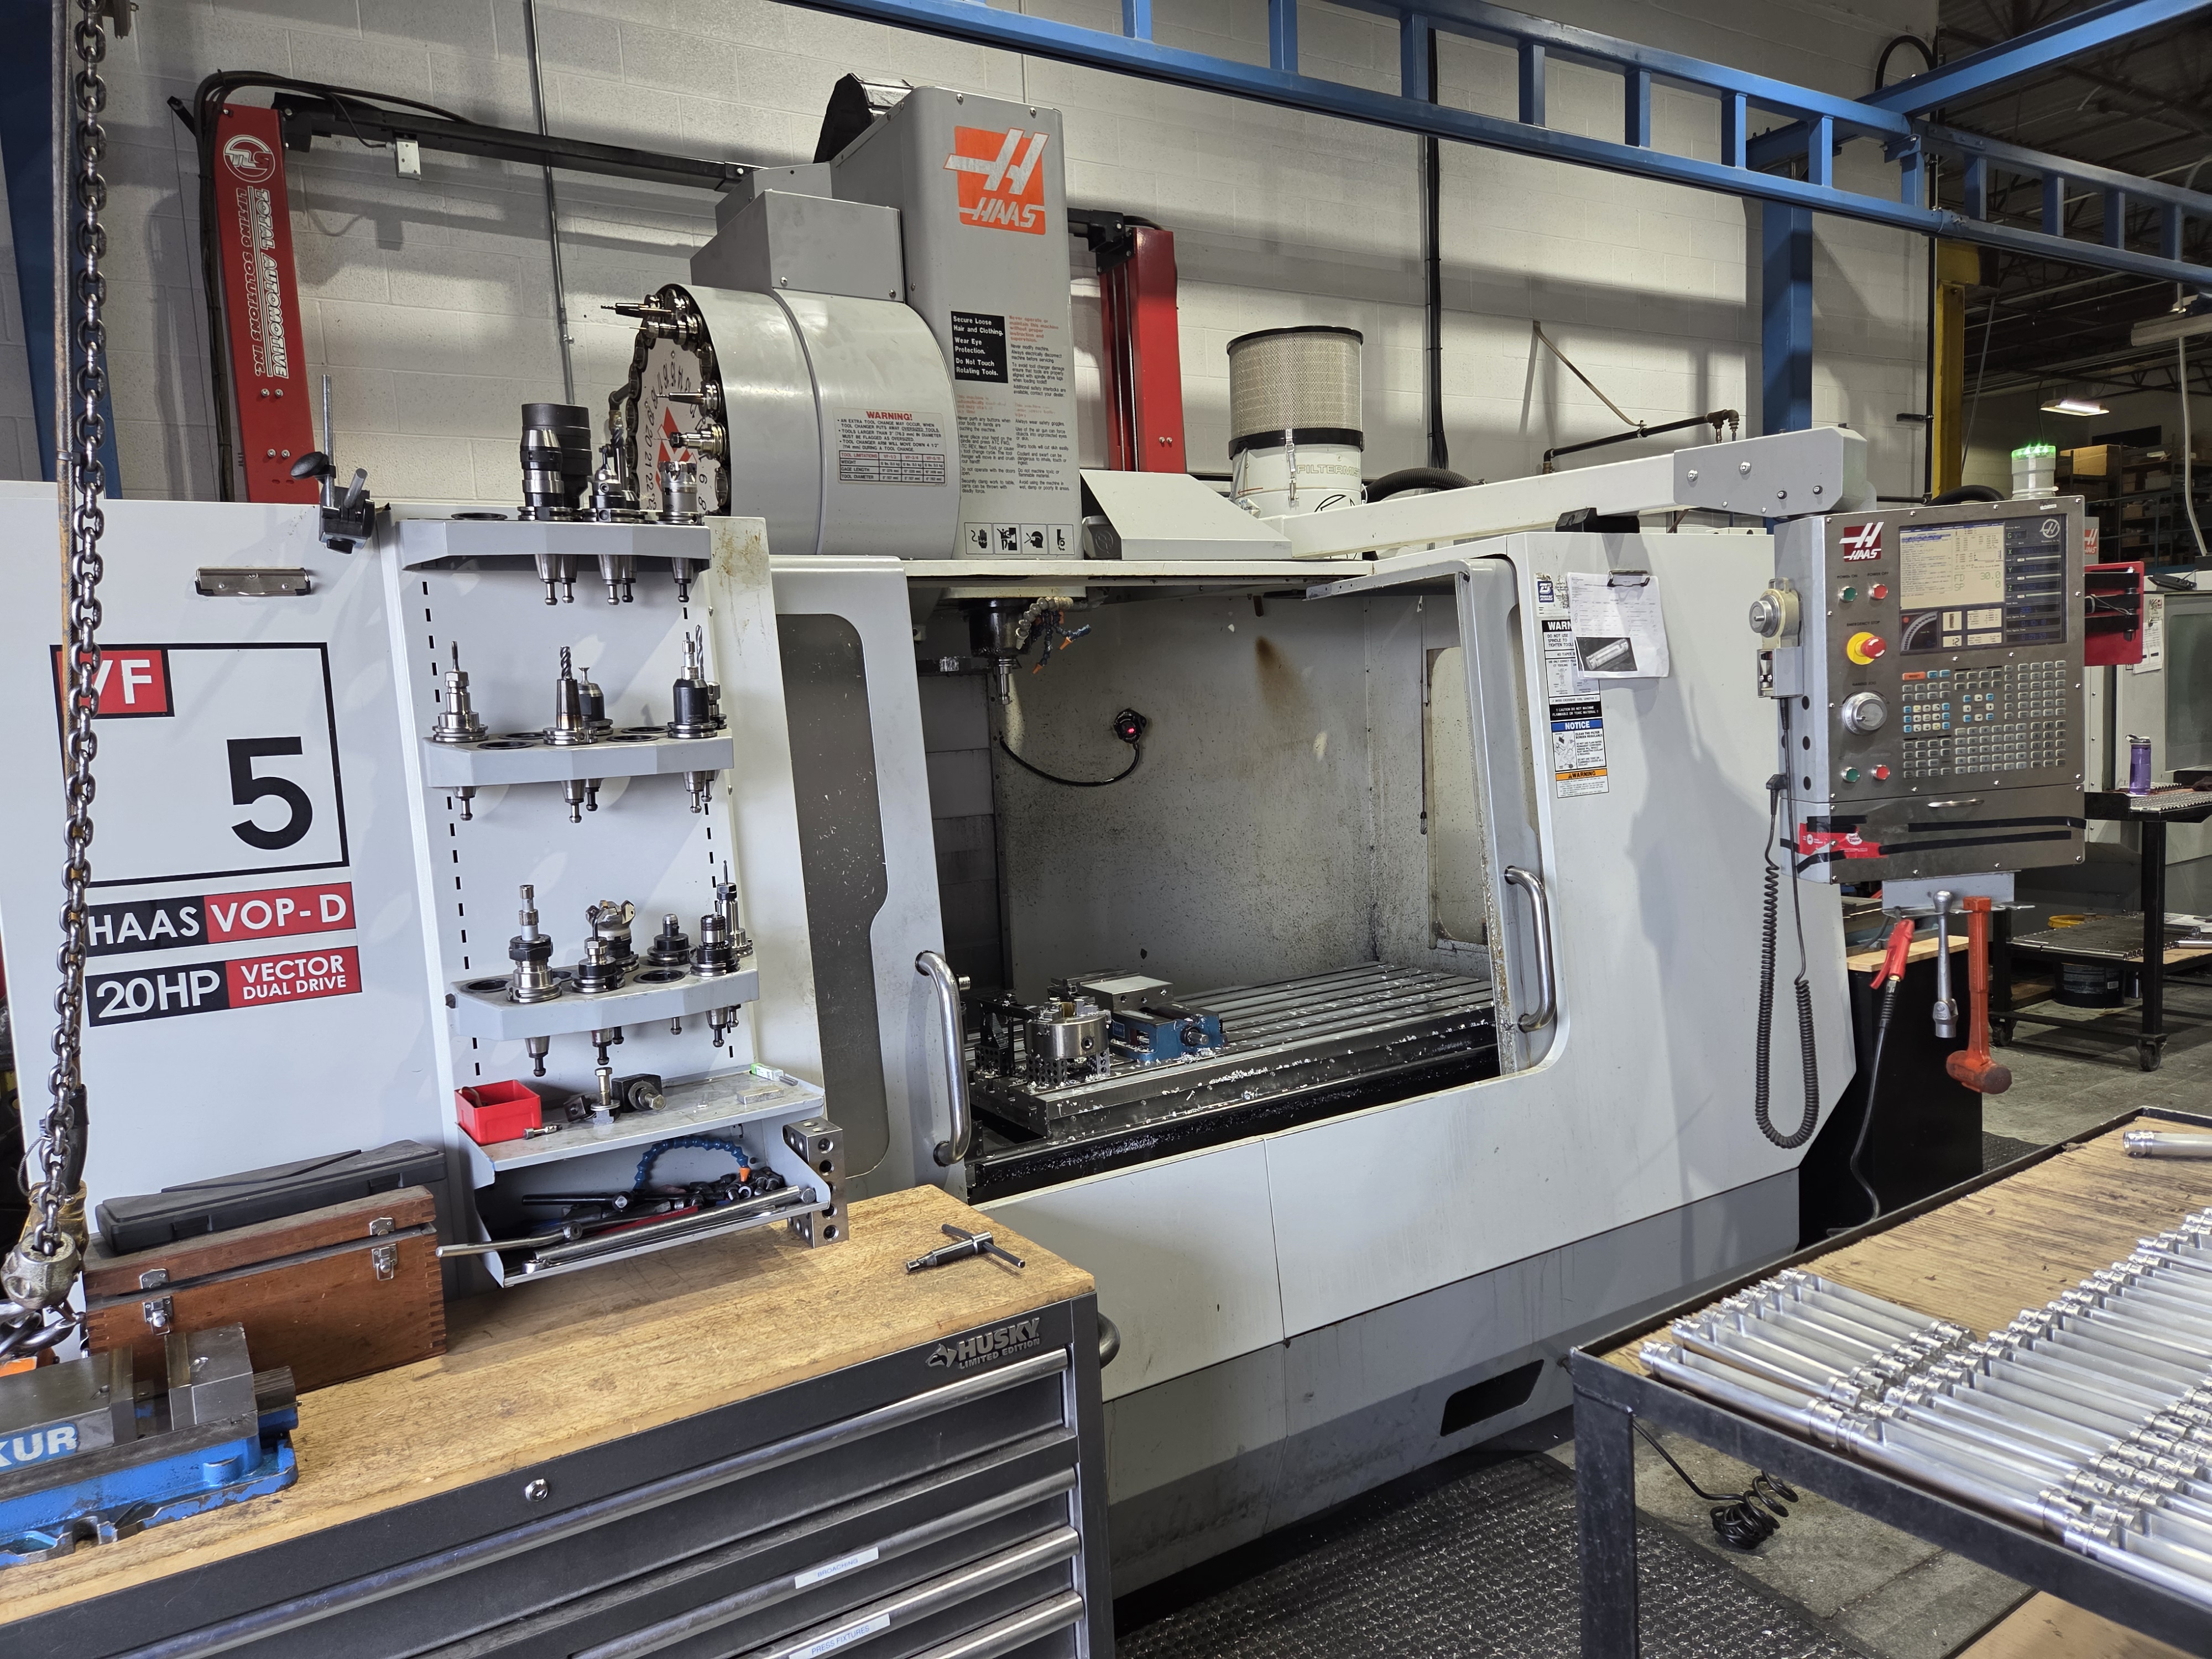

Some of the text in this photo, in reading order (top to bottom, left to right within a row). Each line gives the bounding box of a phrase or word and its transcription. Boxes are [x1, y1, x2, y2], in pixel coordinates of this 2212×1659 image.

[959, 197, 1045, 228] HAAS
[236, 187, 265, 377] LIFTING SOLUTIONS INC.
[255, 188, 289, 379] TOTAL AUTOMOTIVE
[980, 327, 1003, 336] Clothing.
[956, 367, 979, 375] Rotating
[866, 411, 912, 420] WARNING!
[645, 424, 653, 447] 20
[645, 451, 652, 467] 21
[1843, 549, 1881, 560] HAAS
[1565, 721, 1590, 730] NOTICE
[227, 736, 313, 850] 5
[88, 906, 200, 946] HAAS
[241, 955, 345, 984] VECTOR
[96, 969, 220, 1018] 20HP
[243, 975, 346, 1000] DUAL DRIVE
[958, 1317, 1040, 1361] HUSKY
[959, 1338, 1040, 1370] LIMITED EDITION
[817, 1558, 858, 1577] BROACHING
[812, 1625, 870, 1655] PRESS FIXTURES
